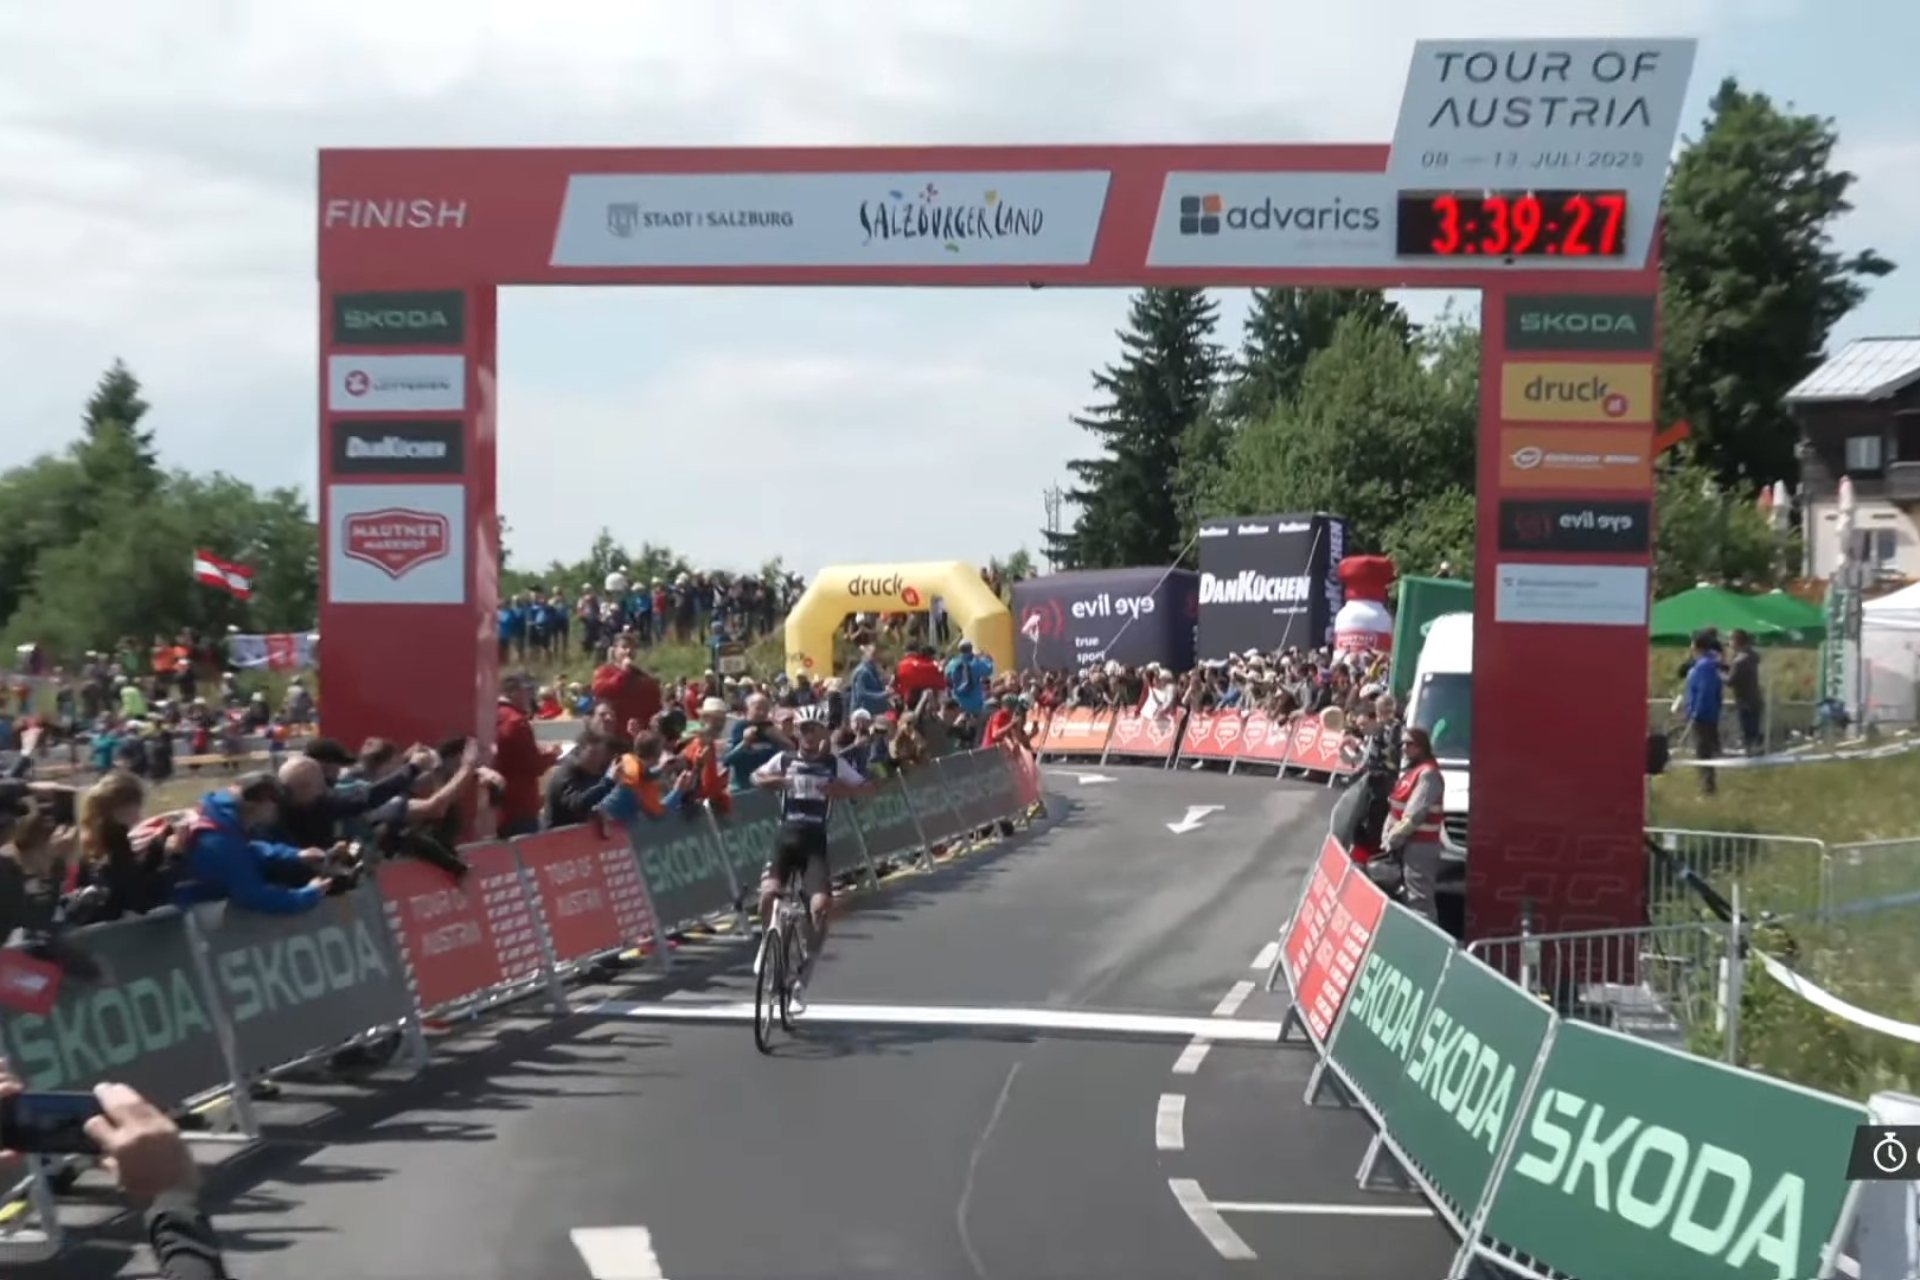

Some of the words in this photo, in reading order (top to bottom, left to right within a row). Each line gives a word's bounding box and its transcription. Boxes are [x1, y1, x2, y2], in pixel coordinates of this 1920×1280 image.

[1434, 52, 1572, 82] TOUR
[1592, 52, 1661, 82] OF
[1428, 97, 1650, 128] AUSTRIA
[1494, 151, 1517, 168] 13
[1531, 151, 1581, 168] JULI
[325, 199, 467, 229] FINISH
[643, 211, 693, 227] STADT
[706, 211, 794, 228] SALZBURG
[1227, 197, 1380, 230] advarics
[1431, 194, 1626, 255] 3:39:27
[1524, 375, 1608, 402] druck
[352, 523, 440, 537] MAUTNER
[1559, 511, 1594, 529] evil
[848, 573, 904, 597] druck
[1072, 593, 1111, 619] evil
[1075, 636, 1100, 648] true
[1076, 650, 1107, 664] sport
[218, 917, 388, 1021] SKODA
[1350, 953, 1424, 1062] SKODA
[10, 967, 211, 1092] SKODA
[1407, 1007, 1516, 1154] SKODA
[1514, 1088, 1805, 1280] SKODA
